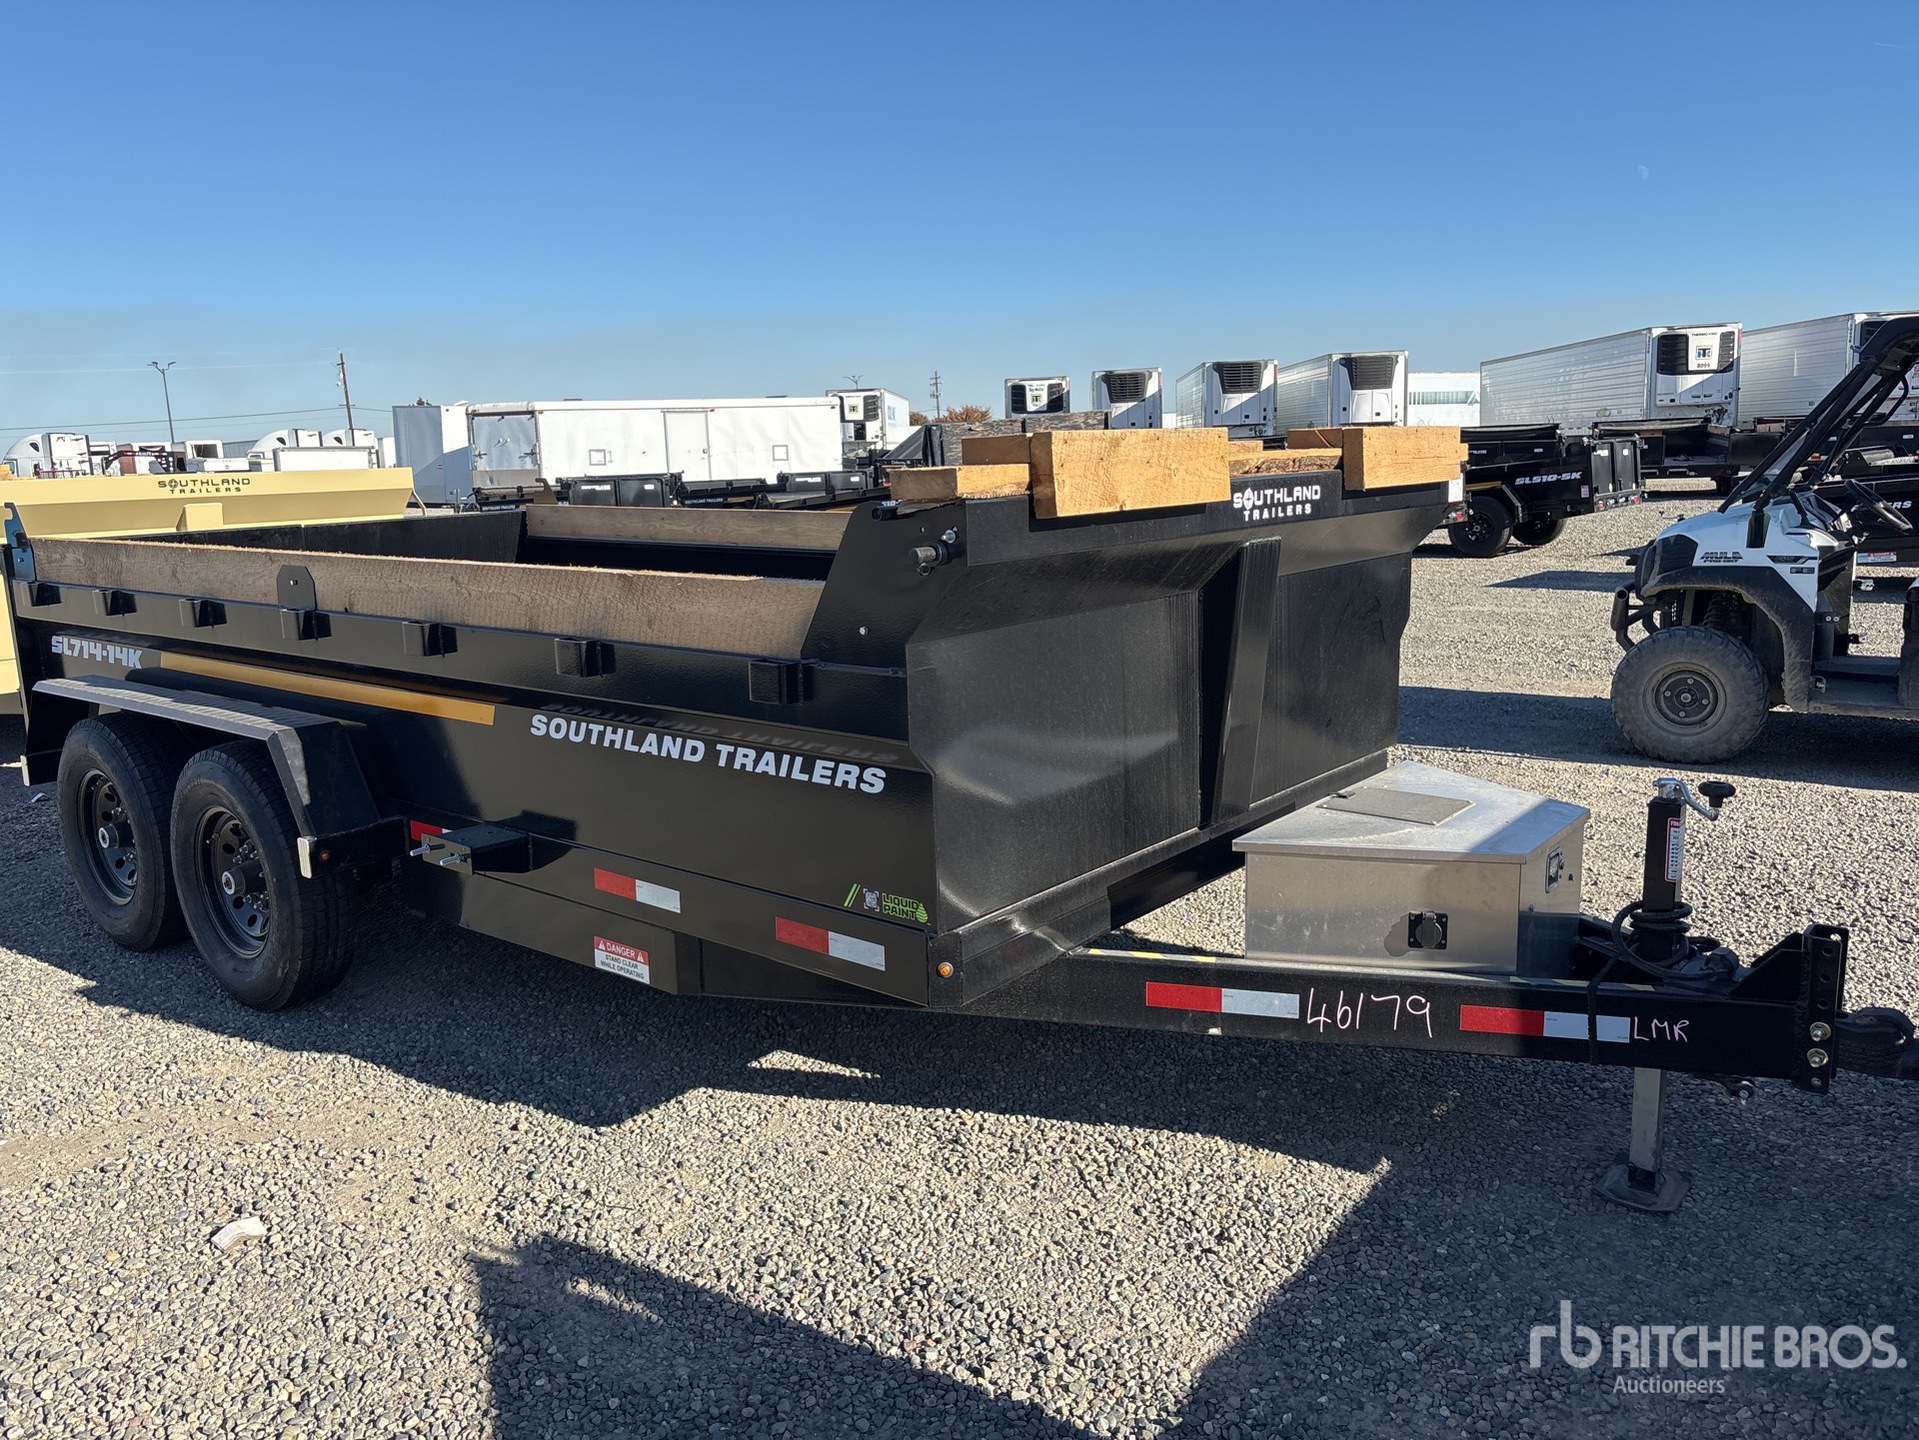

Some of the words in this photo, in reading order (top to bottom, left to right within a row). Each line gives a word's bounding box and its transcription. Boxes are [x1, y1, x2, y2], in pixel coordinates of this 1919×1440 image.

[158, 477, 250, 489] SOUTHLAND
[169, 486, 242, 495] TRAILERS
[1232, 484, 1321, 511] SOUTHLAND
[1243, 502, 1312, 522] TRAILERS
[51, 635, 143, 670] SL714-14K
[530, 714, 706, 763] SOUTHLAND
[716, 743, 887, 794] TRAILERS
[882, 892, 920, 911] LIQUID
[883, 903, 917, 921] PAINT
[606, 941, 636, 960] DANGER
[600, 959, 616, 971] WHILE
[616, 964, 645, 980] OPERATING
[605, 953, 622, 965] STAND
[621, 958, 639, 970] CLEAR
[1306, 987, 1433, 1038] 46179
[1634, 1016, 1690, 1043] LMR
